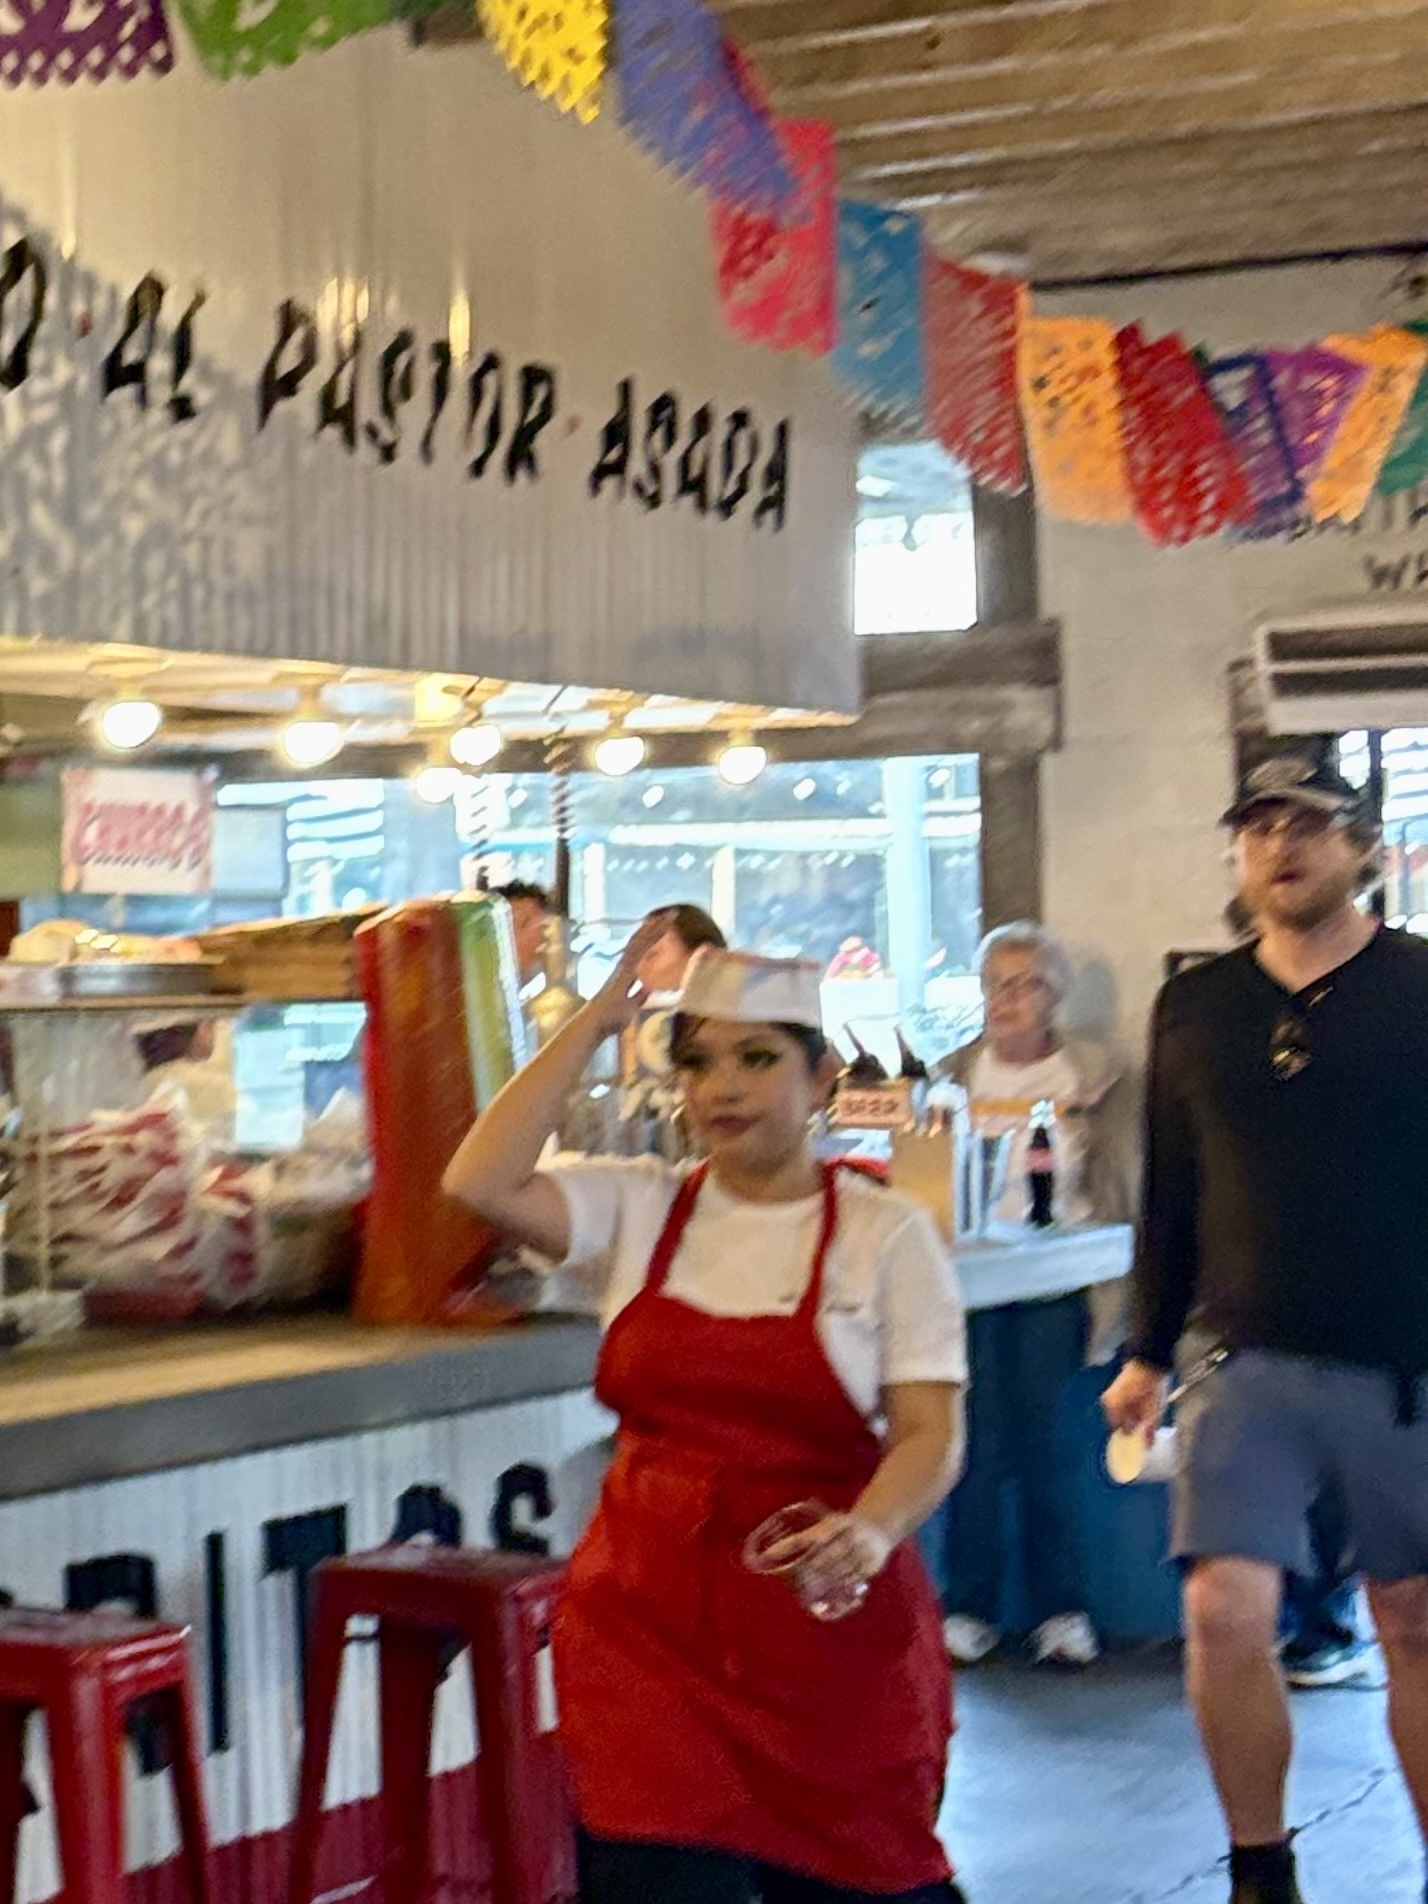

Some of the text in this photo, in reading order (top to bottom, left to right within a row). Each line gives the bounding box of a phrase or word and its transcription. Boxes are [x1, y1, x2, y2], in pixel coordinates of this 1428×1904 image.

[101, 274, 209, 424] AL
[256, 299, 557, 486] PASTOR
[588, 376, 794, 535] ASADA
